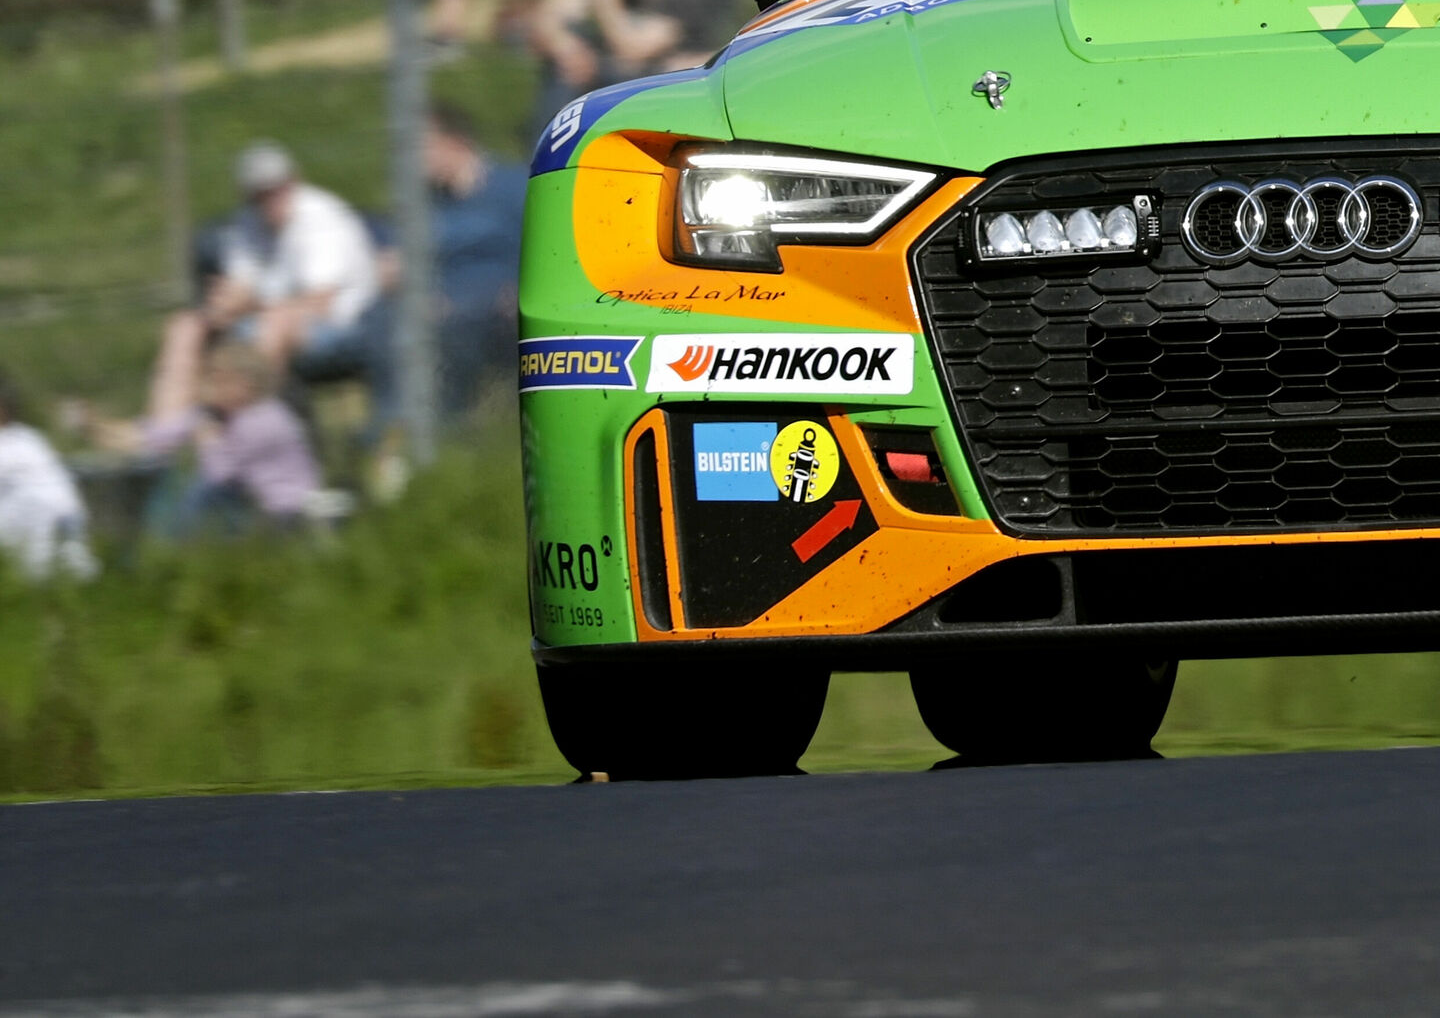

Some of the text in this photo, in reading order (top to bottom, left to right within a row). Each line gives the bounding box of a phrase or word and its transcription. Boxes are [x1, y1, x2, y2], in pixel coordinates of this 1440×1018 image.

[596, 284, 785, 307] Optica La Mar
[698, 450, 768, 472] BILSTEIN
[570, 606, 604, 627] 1969
